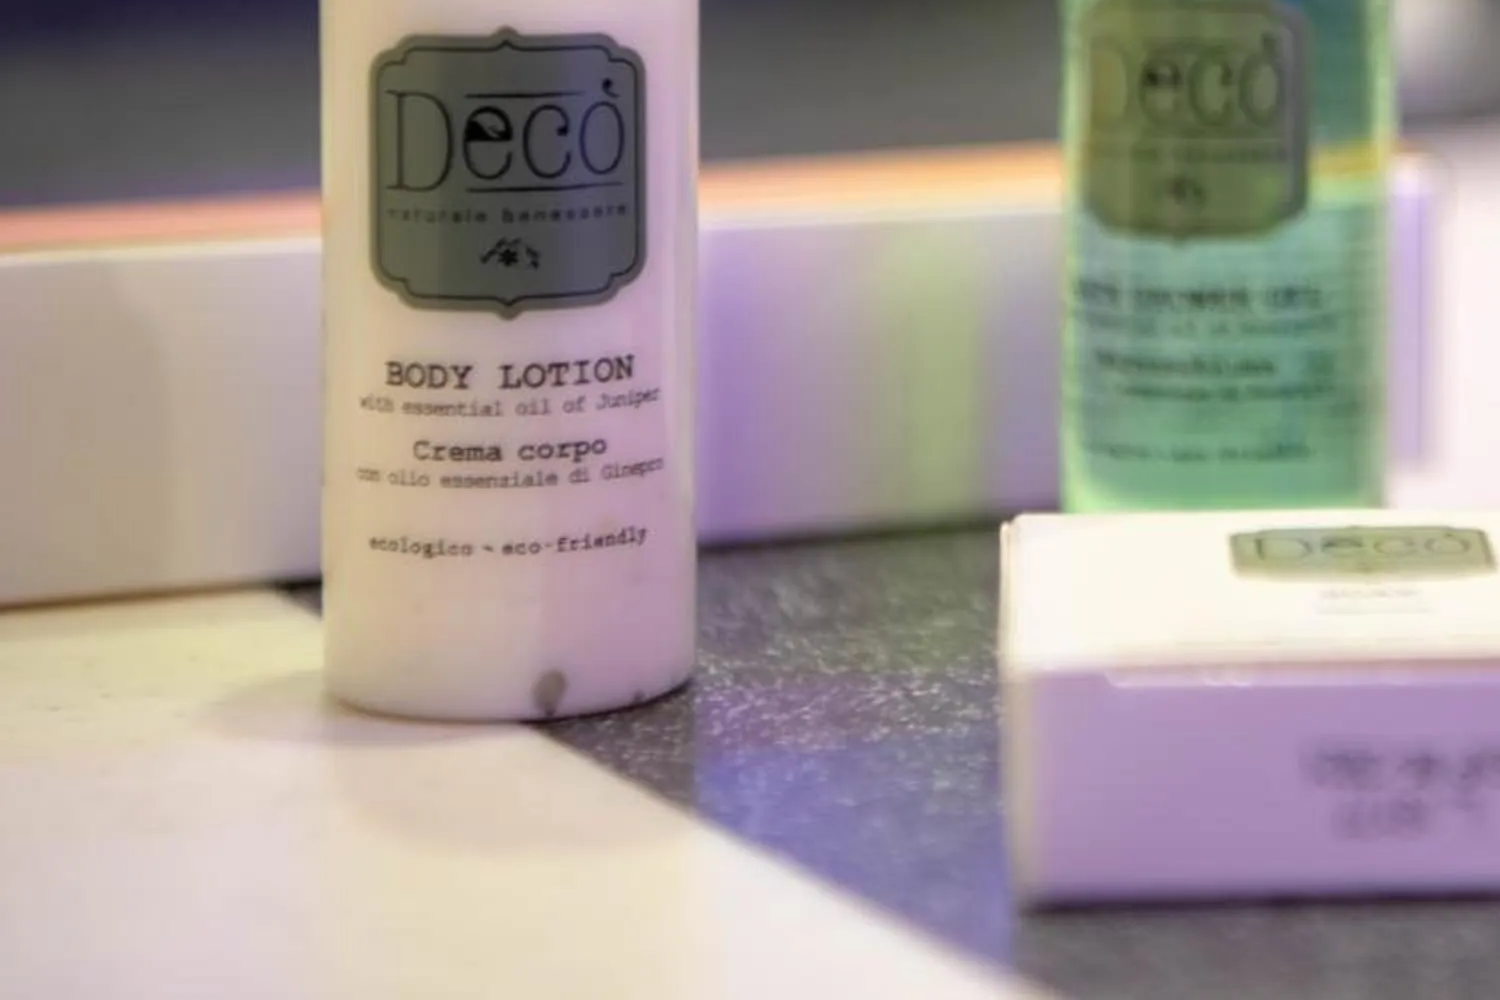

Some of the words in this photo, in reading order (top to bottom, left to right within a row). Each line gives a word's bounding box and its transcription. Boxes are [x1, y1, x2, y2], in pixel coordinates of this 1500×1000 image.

[384, 77, 626, 193] Decò
[385, 360, 474, 390] BODY
[497, 353, 636, 390] LOTION
[359, 393, 395, 413] with
[402, 398, 504, 418] essential
[515, 397, 553, 417] oil
[562, 395, 586, 414] of
[595, 387, 661, 412] Juniper
[412, 439, 503, 463] Crema
[518, 438, 608, 464] corpo
[389, 467, 431, 488] olio
[440, 467, 559, 489] essenziale
[568, 465, 591, 485] di
[368, 535, 474, 560] ecologico
[502, 526, 649, 556] eco-friendly
